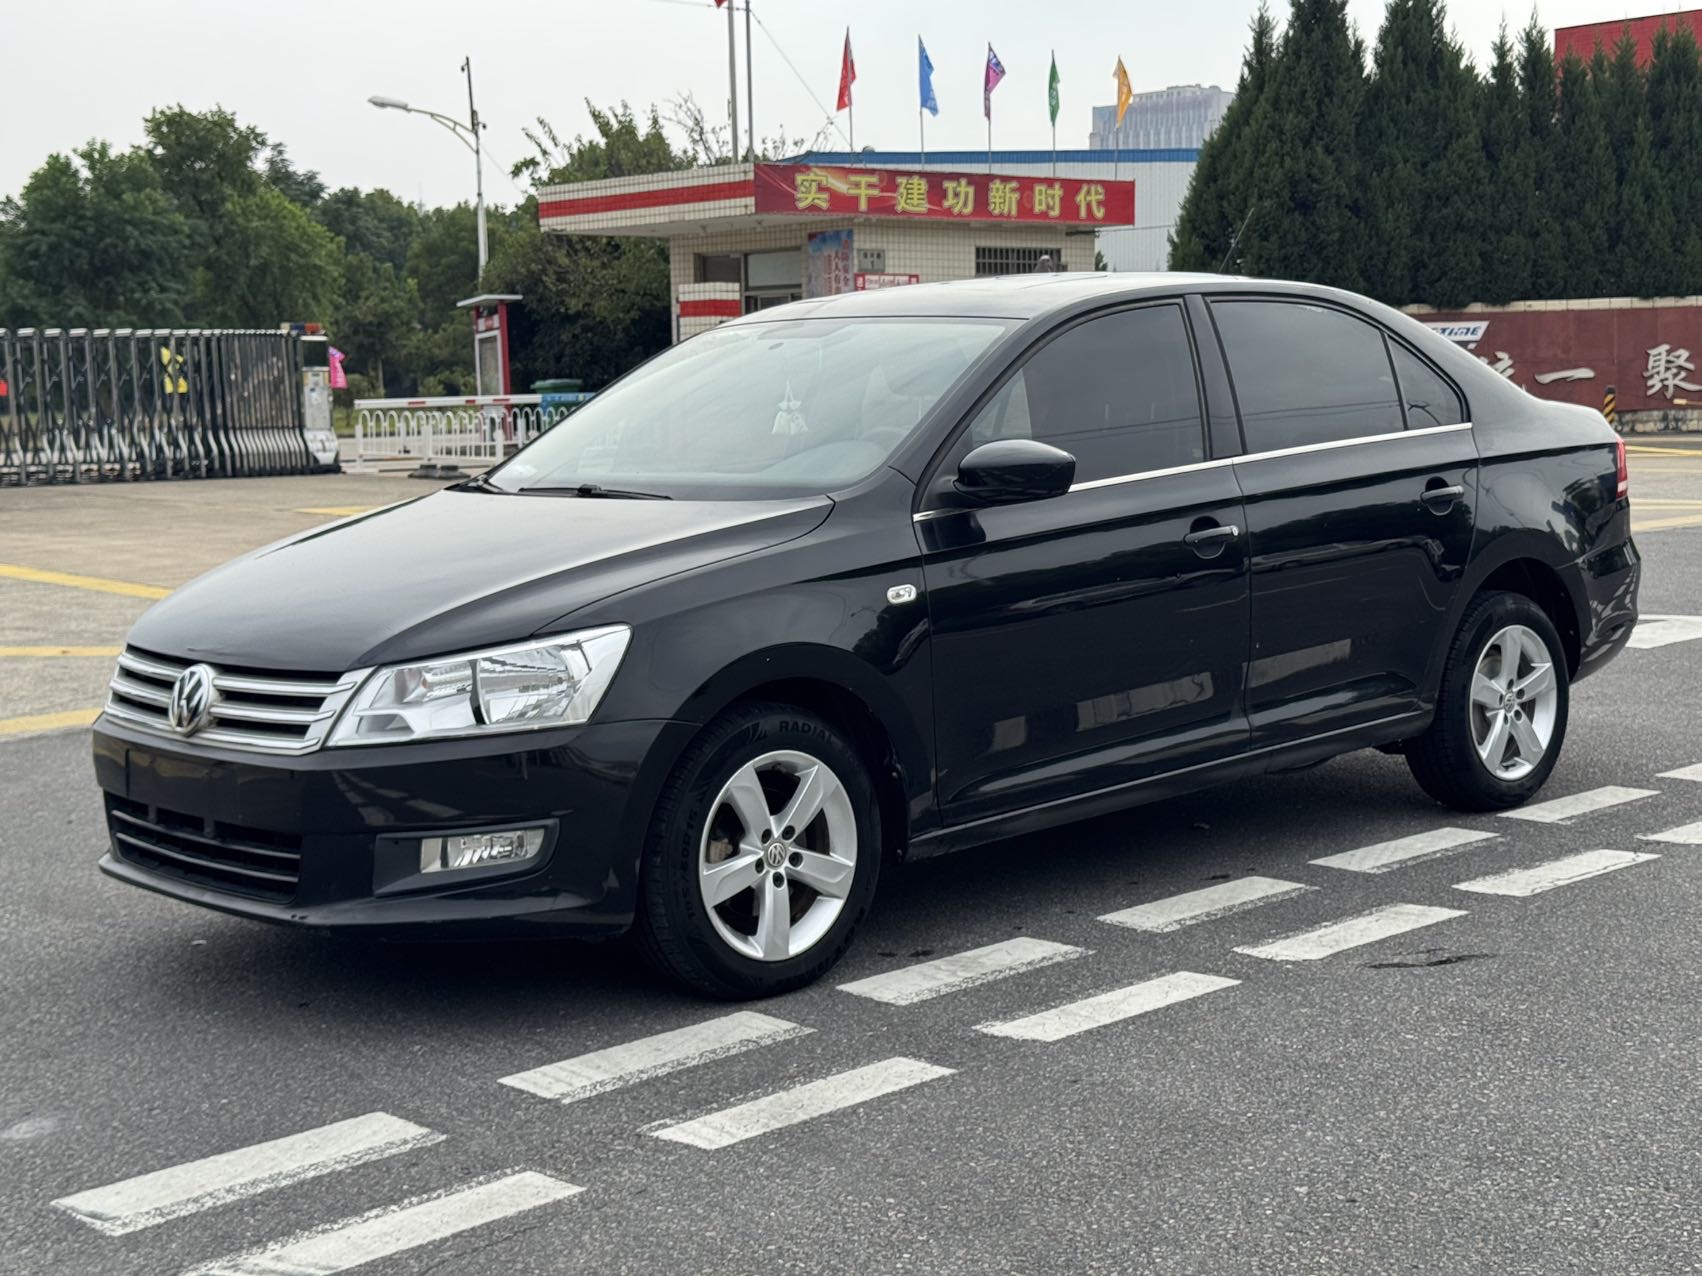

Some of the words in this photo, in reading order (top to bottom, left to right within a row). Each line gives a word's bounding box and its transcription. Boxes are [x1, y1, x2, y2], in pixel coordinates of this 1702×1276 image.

[795, 173, 1105, 219] 实干建功新时代
